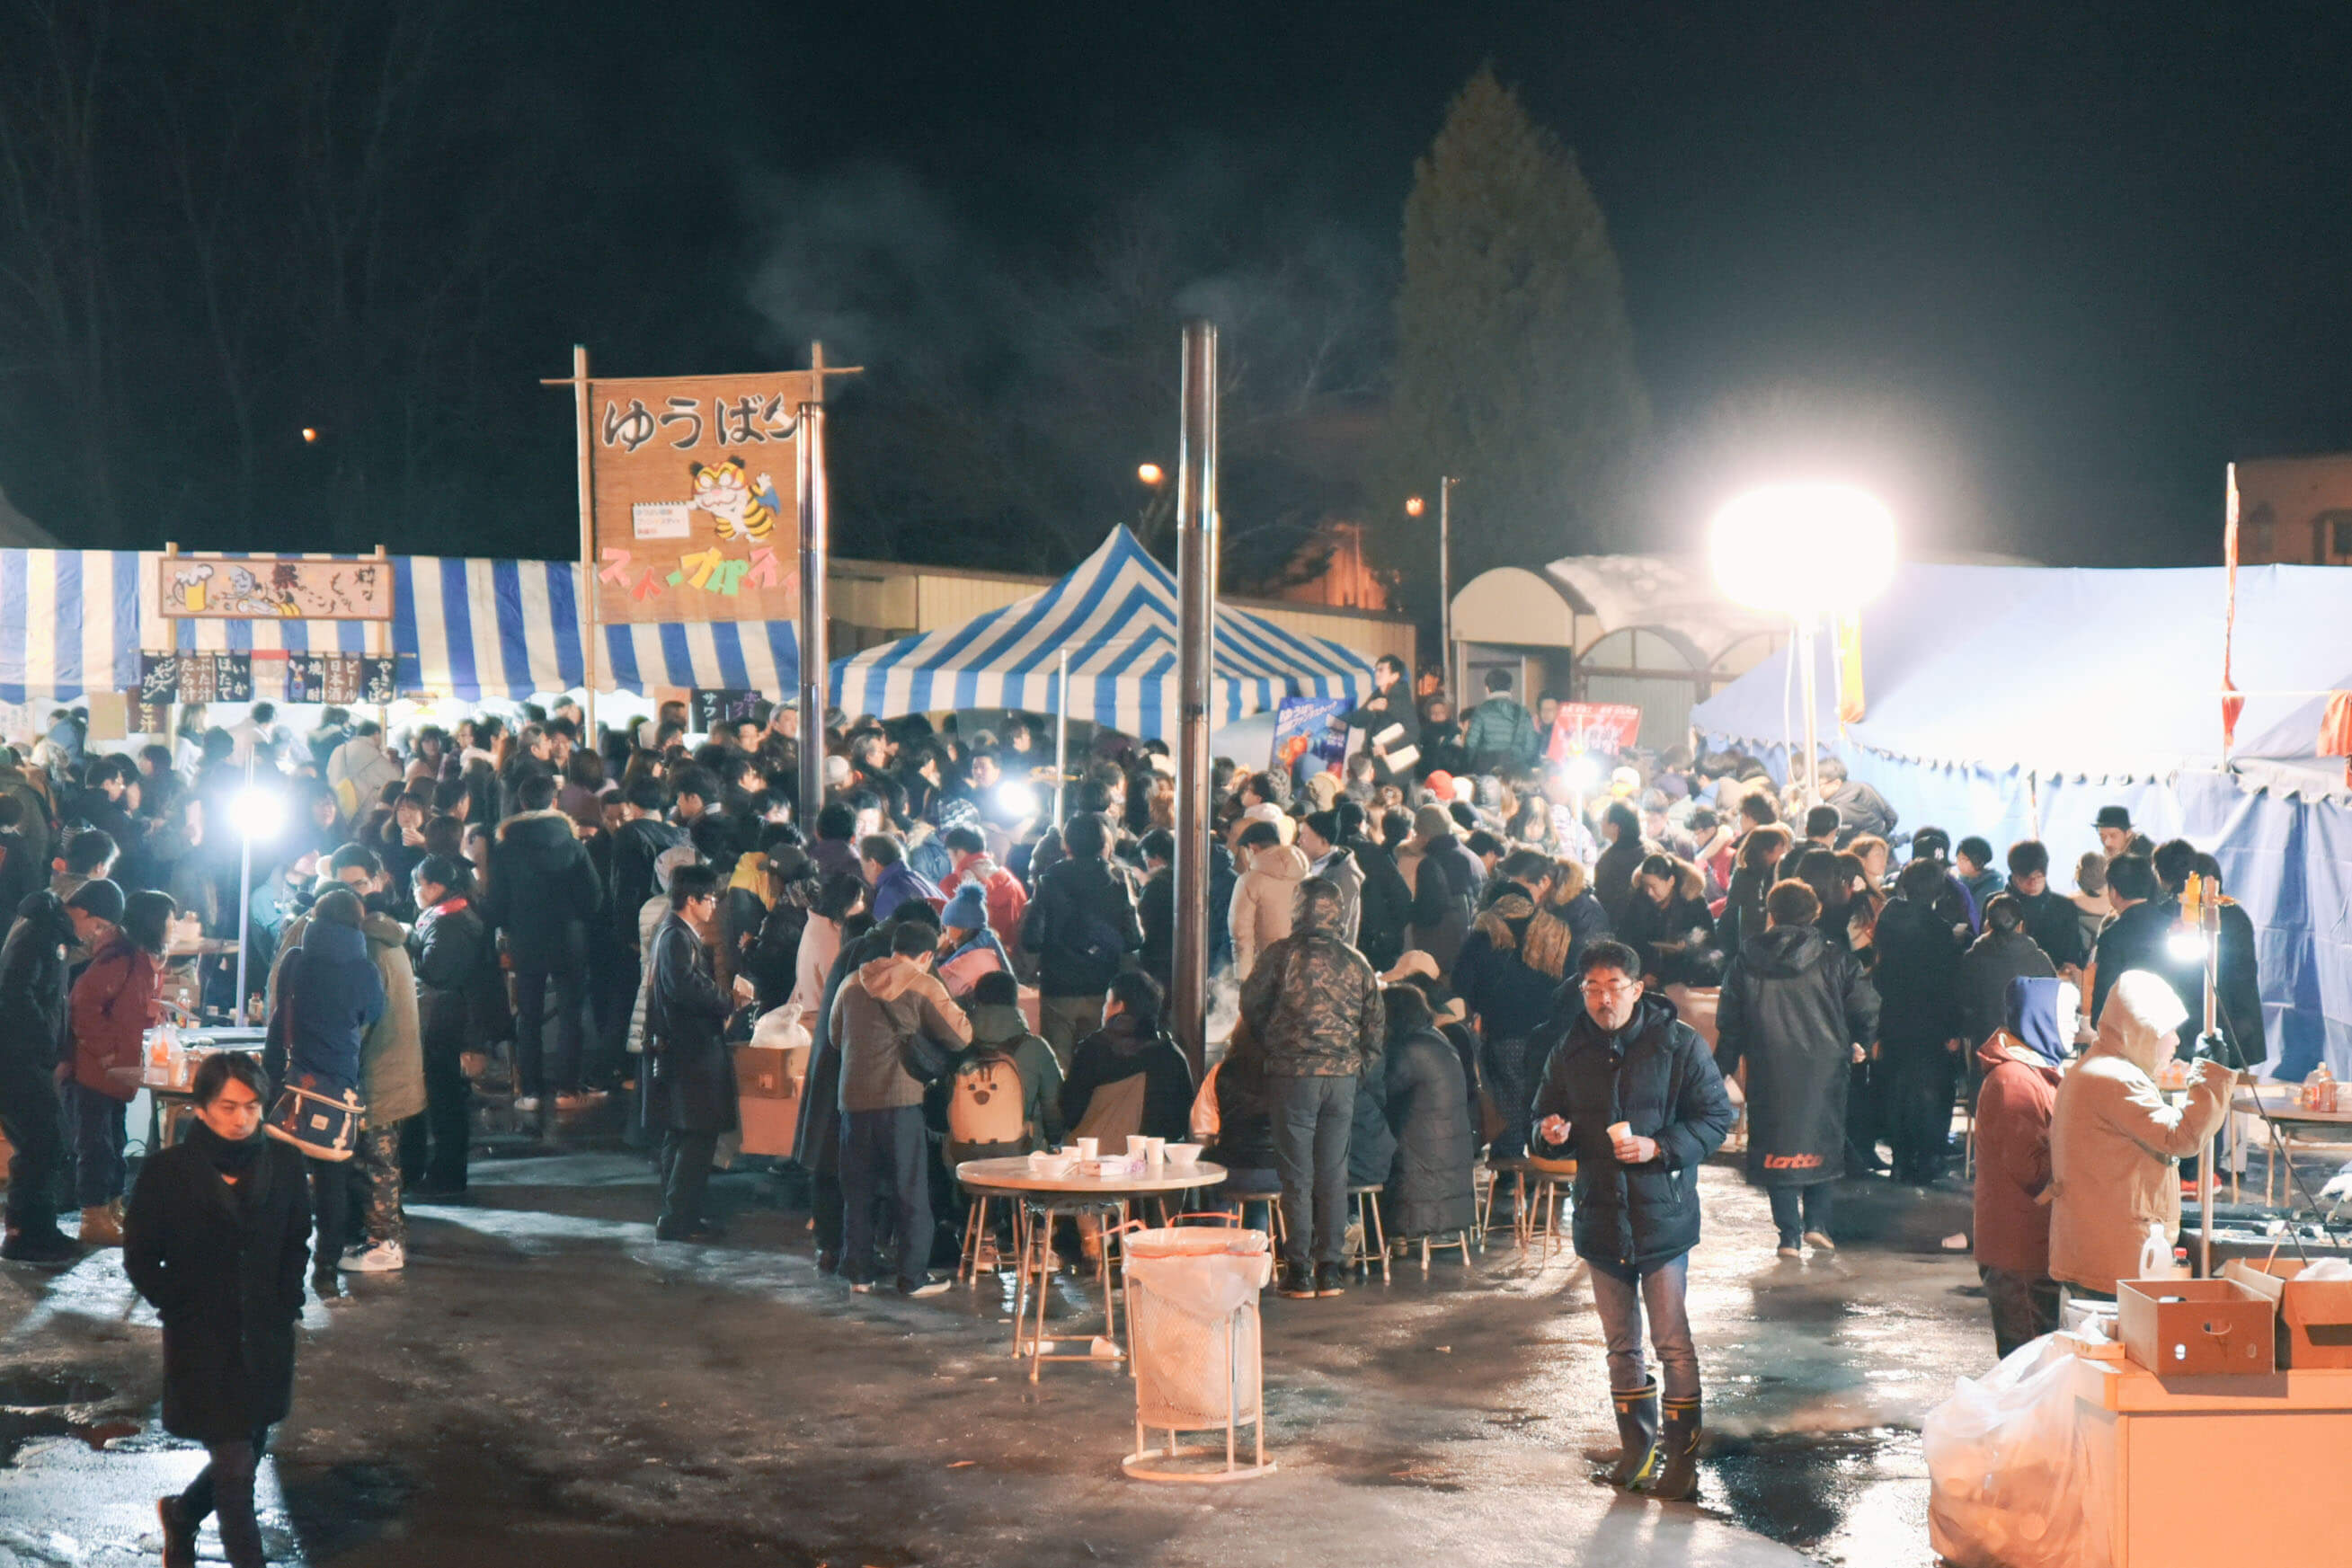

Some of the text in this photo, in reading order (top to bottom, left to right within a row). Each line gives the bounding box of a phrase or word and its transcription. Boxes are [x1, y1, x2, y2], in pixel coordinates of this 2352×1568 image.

[217, 657, 233, 701] ほたて
[233, 664, 248, 696] いか
[327, 660, 344, 701] 日本酒
[344, 660, 359, 700] ビール
